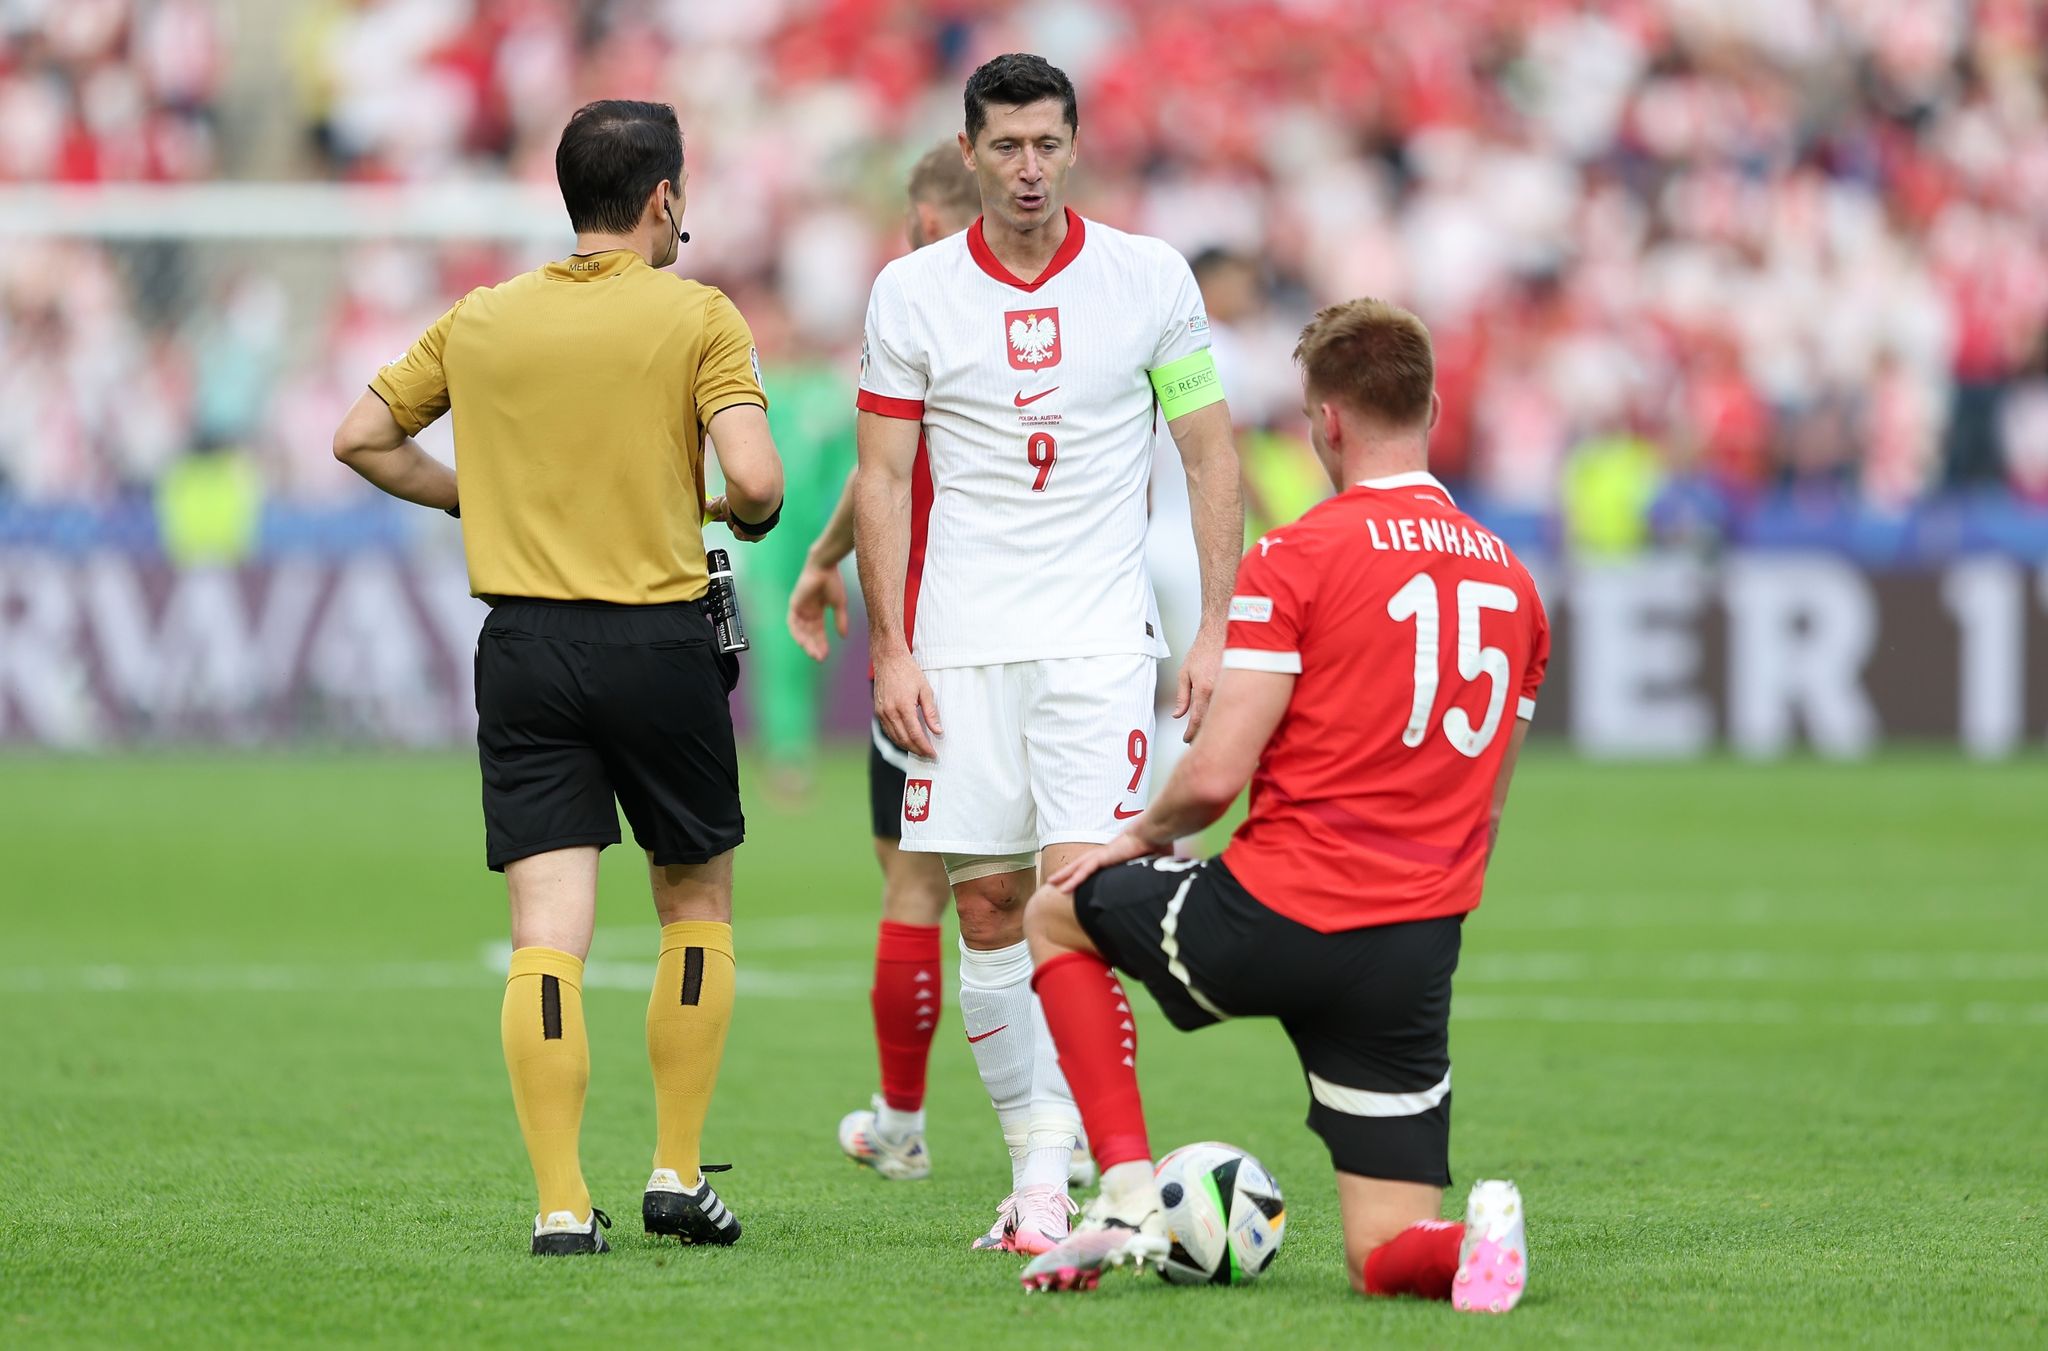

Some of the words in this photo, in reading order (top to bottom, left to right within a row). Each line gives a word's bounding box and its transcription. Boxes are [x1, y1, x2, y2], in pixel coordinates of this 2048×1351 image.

[568, 261, 600, 272] MELER
[1178, 370, 1215, 392] RESPECT
[1027, 431, 1058, 493] 9
[1366, 518, 1510, 568] LIENHART
[1387, 571, 1519, 759] 15
[1127, 729, 1148, 794] 9
